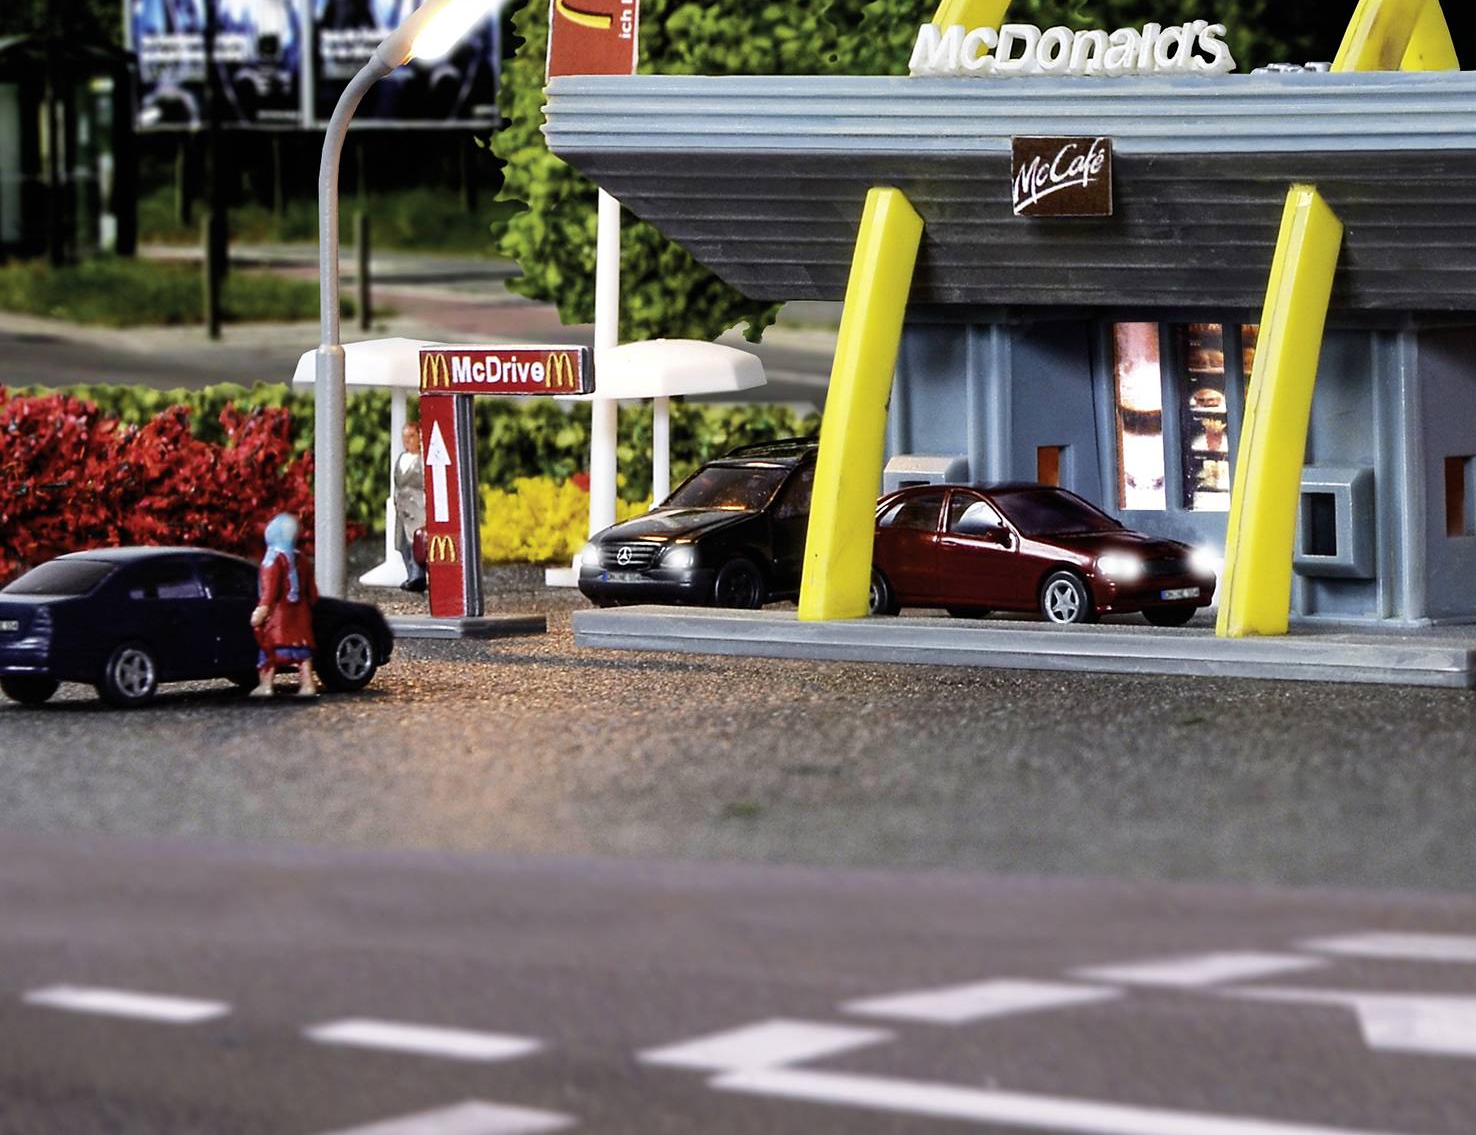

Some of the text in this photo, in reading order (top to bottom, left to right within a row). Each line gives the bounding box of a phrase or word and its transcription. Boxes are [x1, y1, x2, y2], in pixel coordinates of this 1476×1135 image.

[618, 9, 633, 39] ich
[908, 20, 1236, 77] McDonald's
[1013, 137, 1105, 210] McCafé
[451, 356, 545, 384] McDrive
